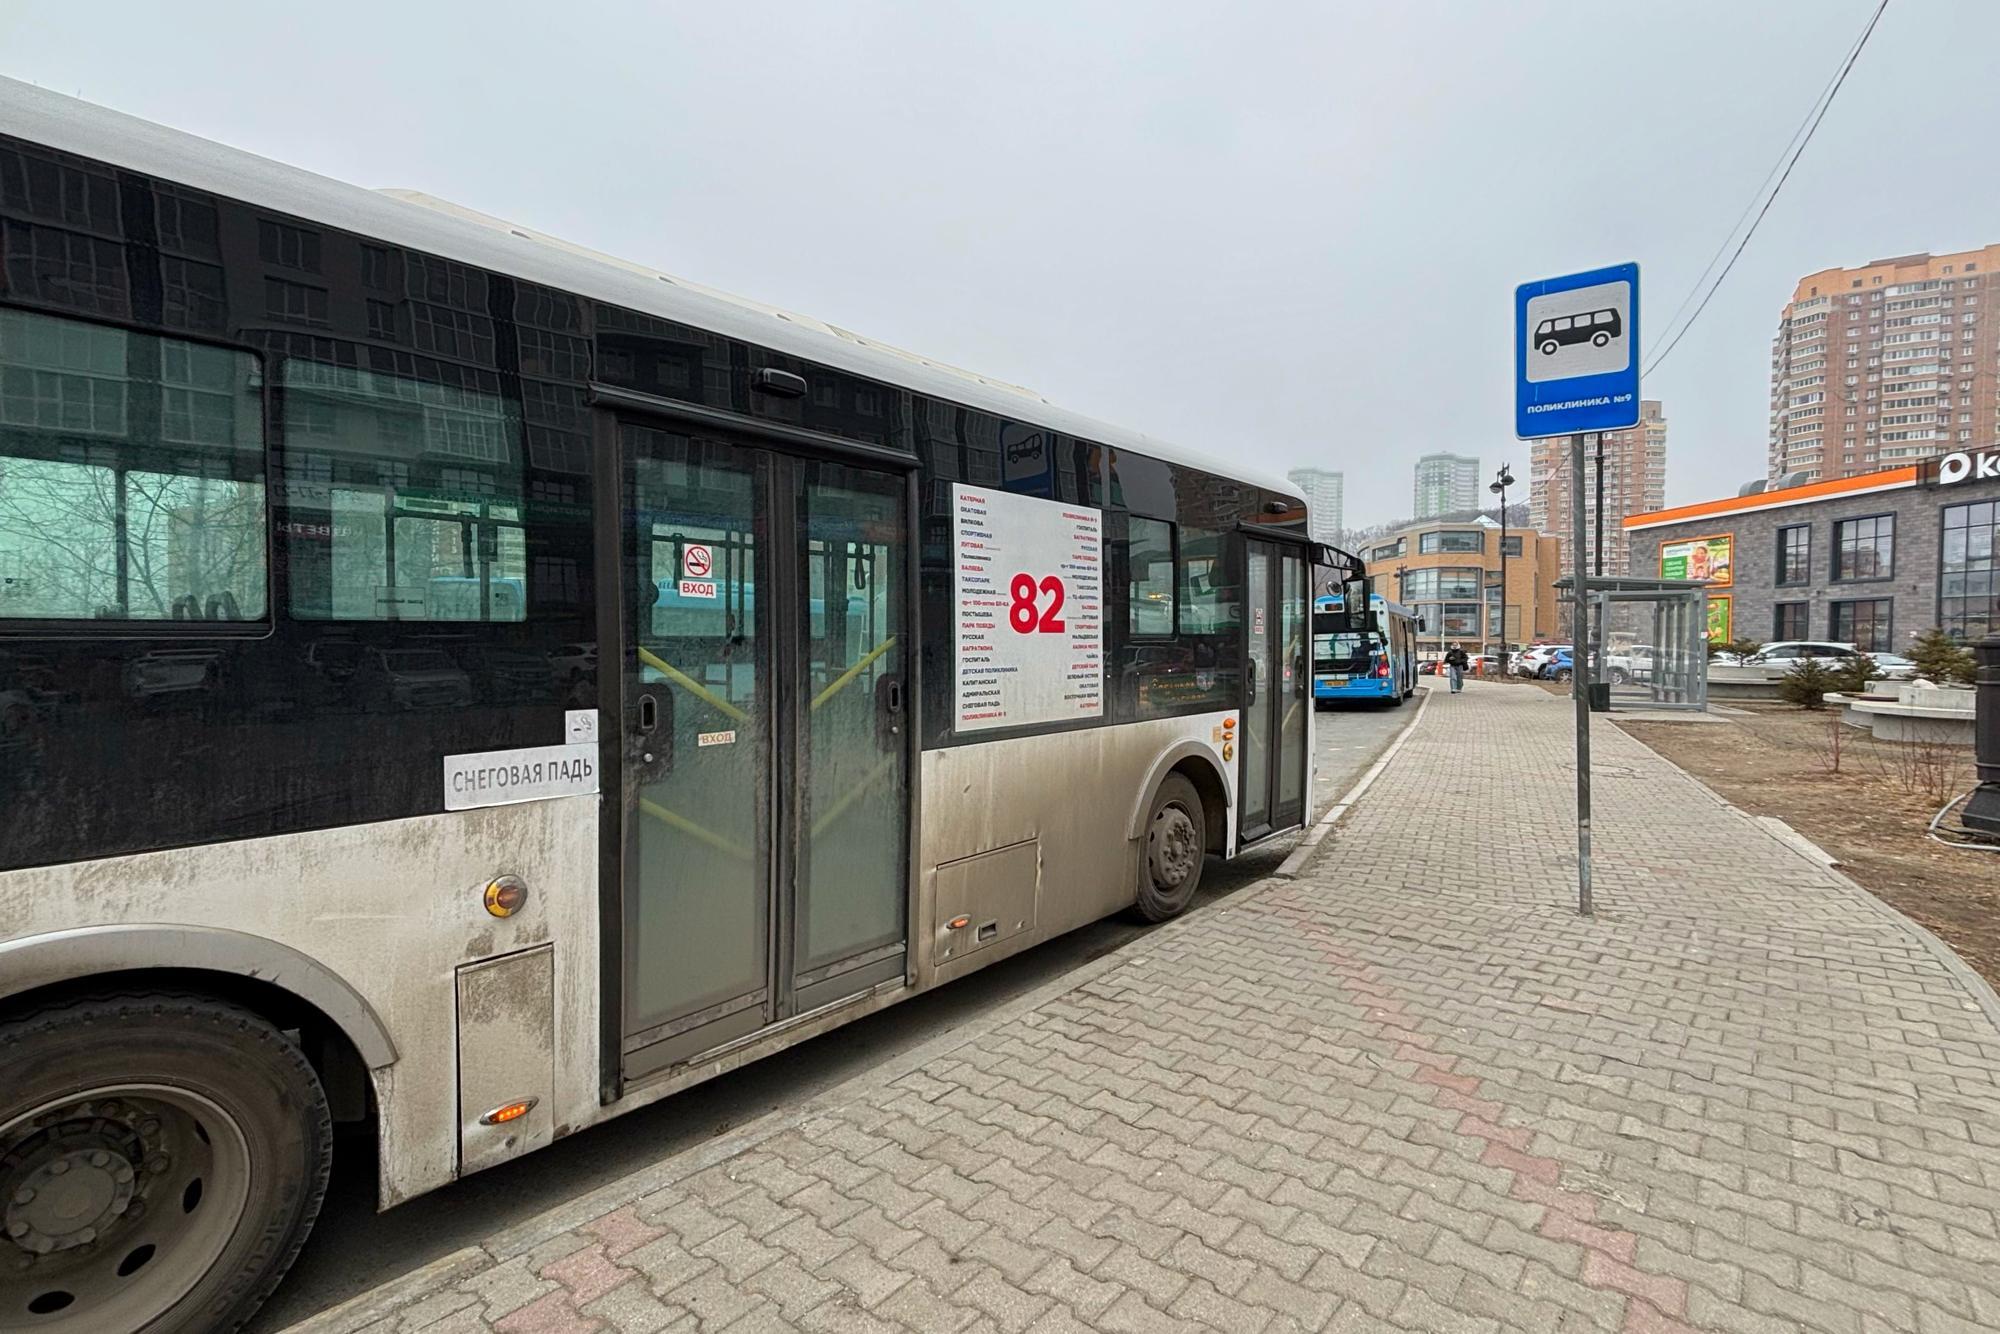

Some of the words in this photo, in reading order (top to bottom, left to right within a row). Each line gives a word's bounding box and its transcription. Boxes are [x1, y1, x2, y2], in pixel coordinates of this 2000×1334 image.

[1527, 396, 1610, 414] ПОЛИКЛИНИКА
[1613, 393, 1632, 403] №9
[682, 582, 714, 596] ВХОД
[1009, 573, 1065, 634] 82
[702, 733, 732, 743] ВХОД
[453, 763, 542, 792] СНЕГОВАЯ
[548, 759, 593, 783] ПАДЬ
